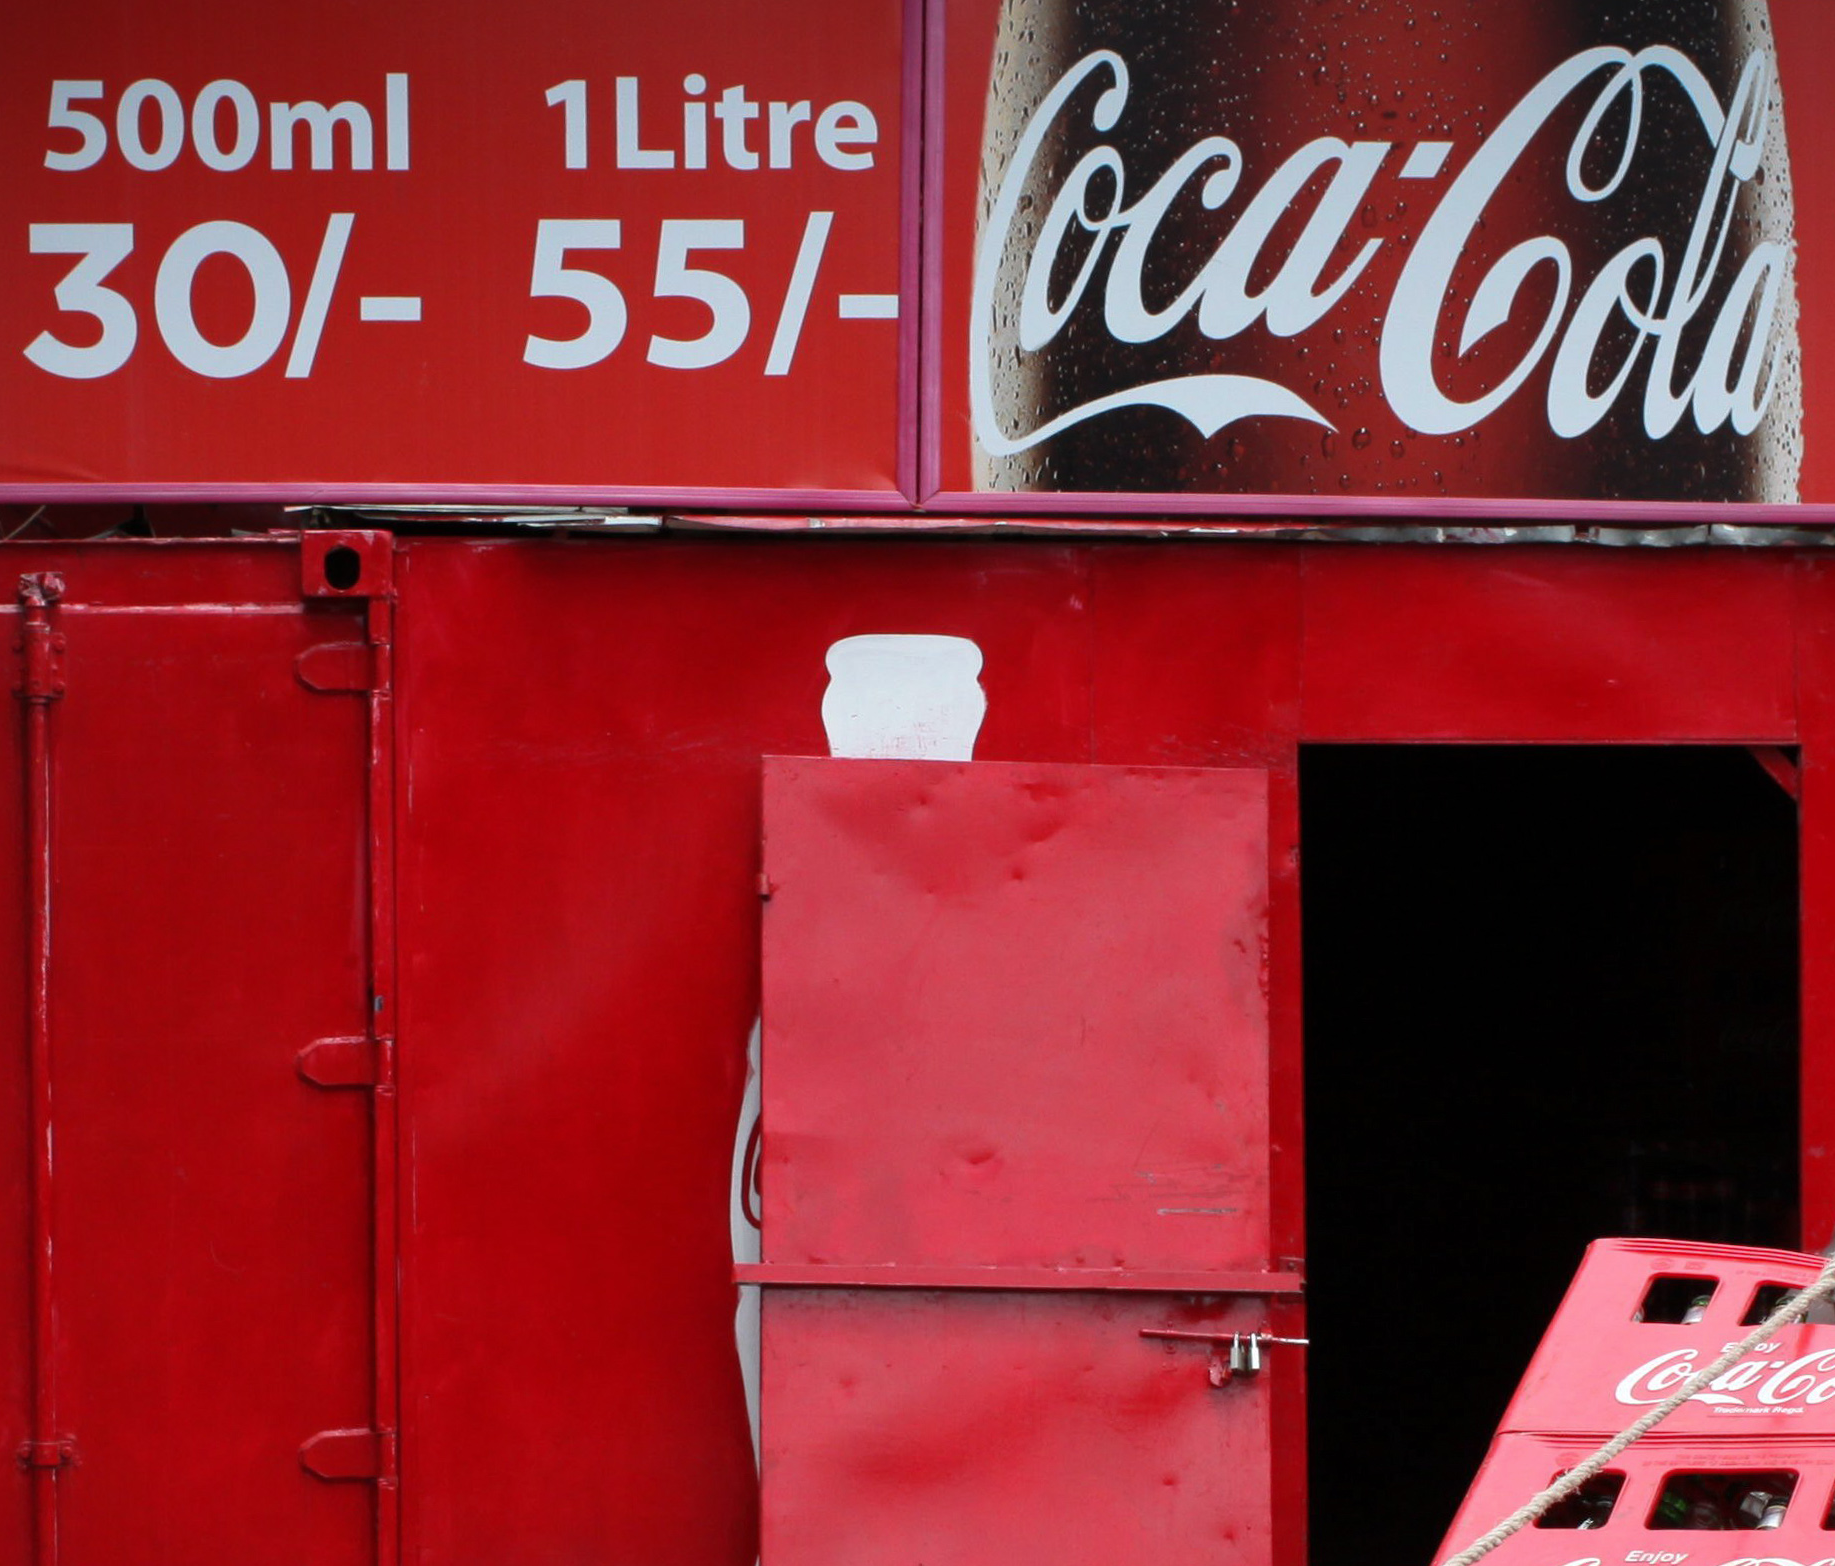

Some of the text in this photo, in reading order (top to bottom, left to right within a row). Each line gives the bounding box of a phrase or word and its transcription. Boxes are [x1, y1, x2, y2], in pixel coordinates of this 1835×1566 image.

[44, 72, 410, 172] 500ml
[544, 73, 879, 170] 1Litre
[22, 212, 422, 379] 30/-
[522, 211, 899, 375] 55/-
[969, 44, 1786, 458] Coca-Cola
[1721, 1342, 1781, 1353] Eoy
[1624, 1550, 1689, 1565] Enjoy
